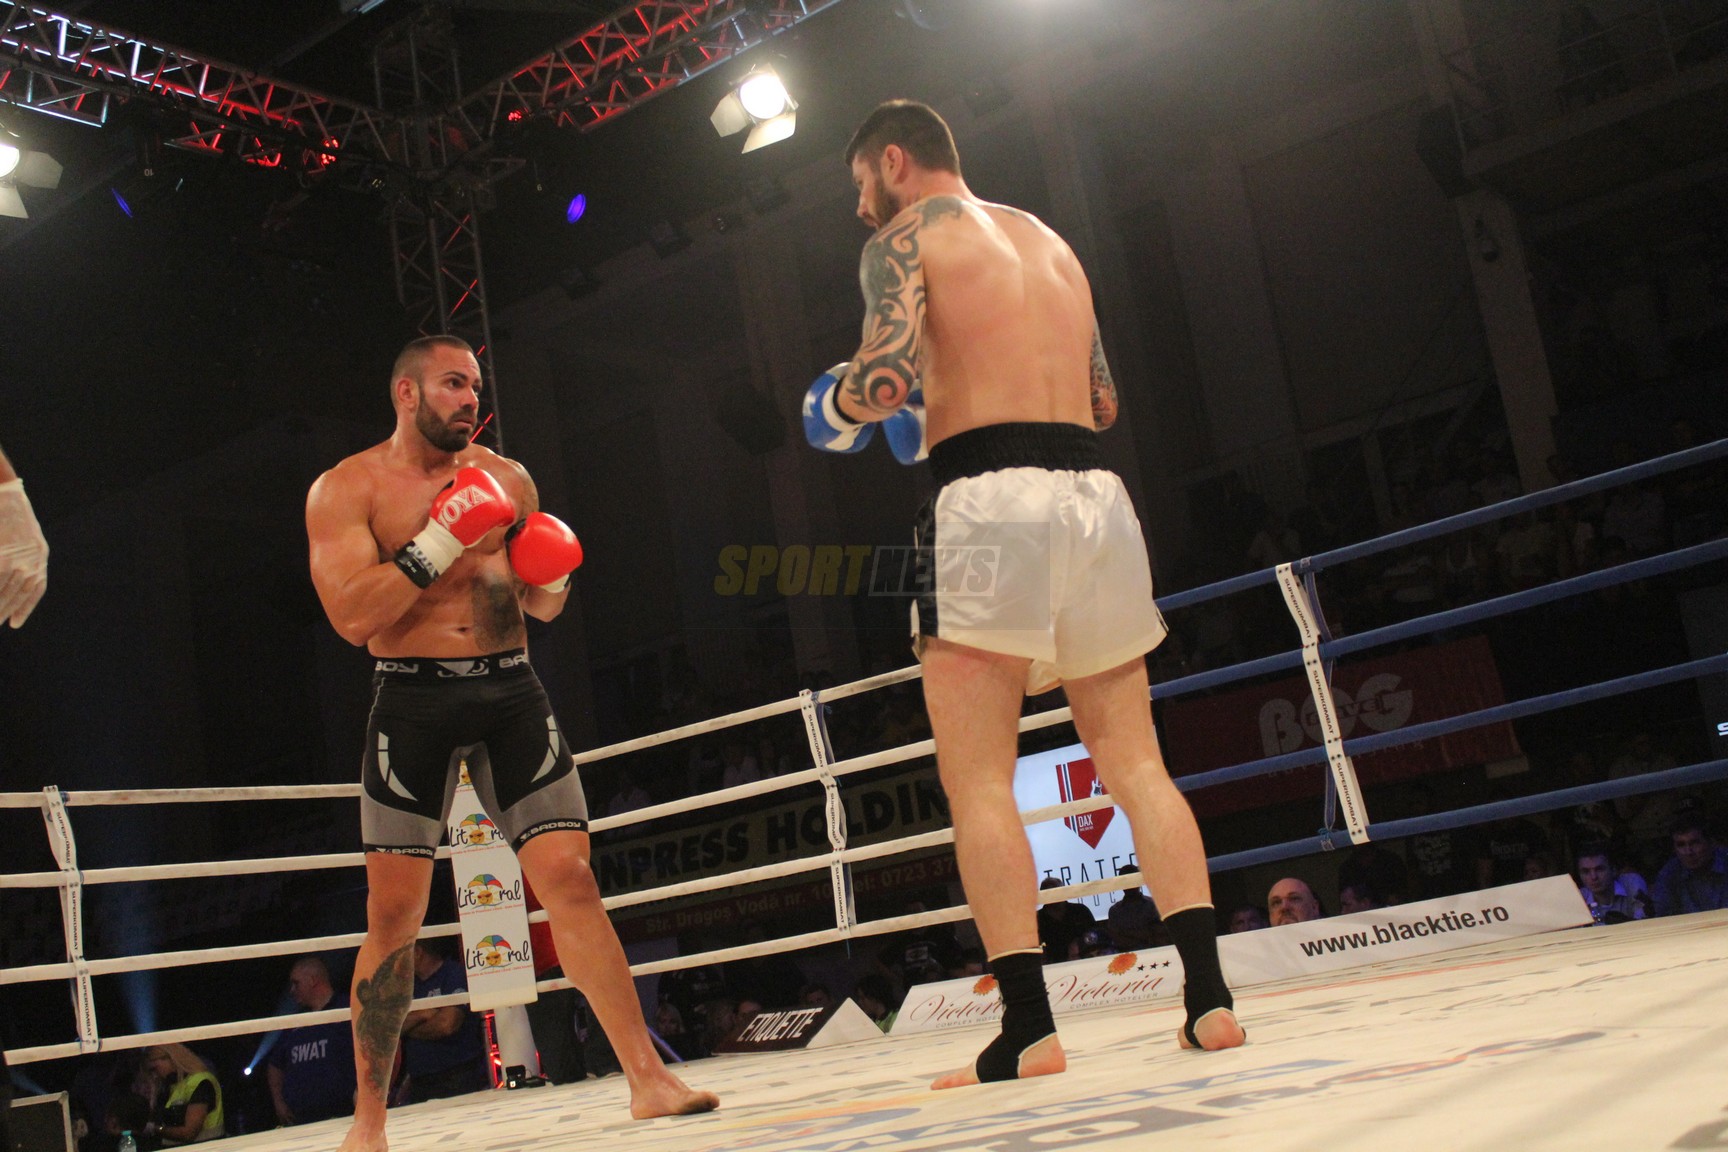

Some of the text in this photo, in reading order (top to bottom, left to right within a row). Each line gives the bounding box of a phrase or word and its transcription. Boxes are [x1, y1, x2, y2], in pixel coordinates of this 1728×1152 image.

[498, 654, 528, 669] BA
[1313, 669, 1335, 735] SUPERKOMBAT
[1337, 762, 1359, 827] SUPERKOMBAT
[594, 779, 951, 892] NPRESS HOLDIN
[1078, 814, 1094, 828] DAX
[880, 863, 927, 888] 0723
[934, 856, 957, 877] 37
[1300, 905, 1510, 957] www.blacktie.ro
[736, 1007, 824, 1043] ETIQUETTE
[910, 994, 1002, 1026] Victori
[291, 1039, 329, 1064] SWAT
